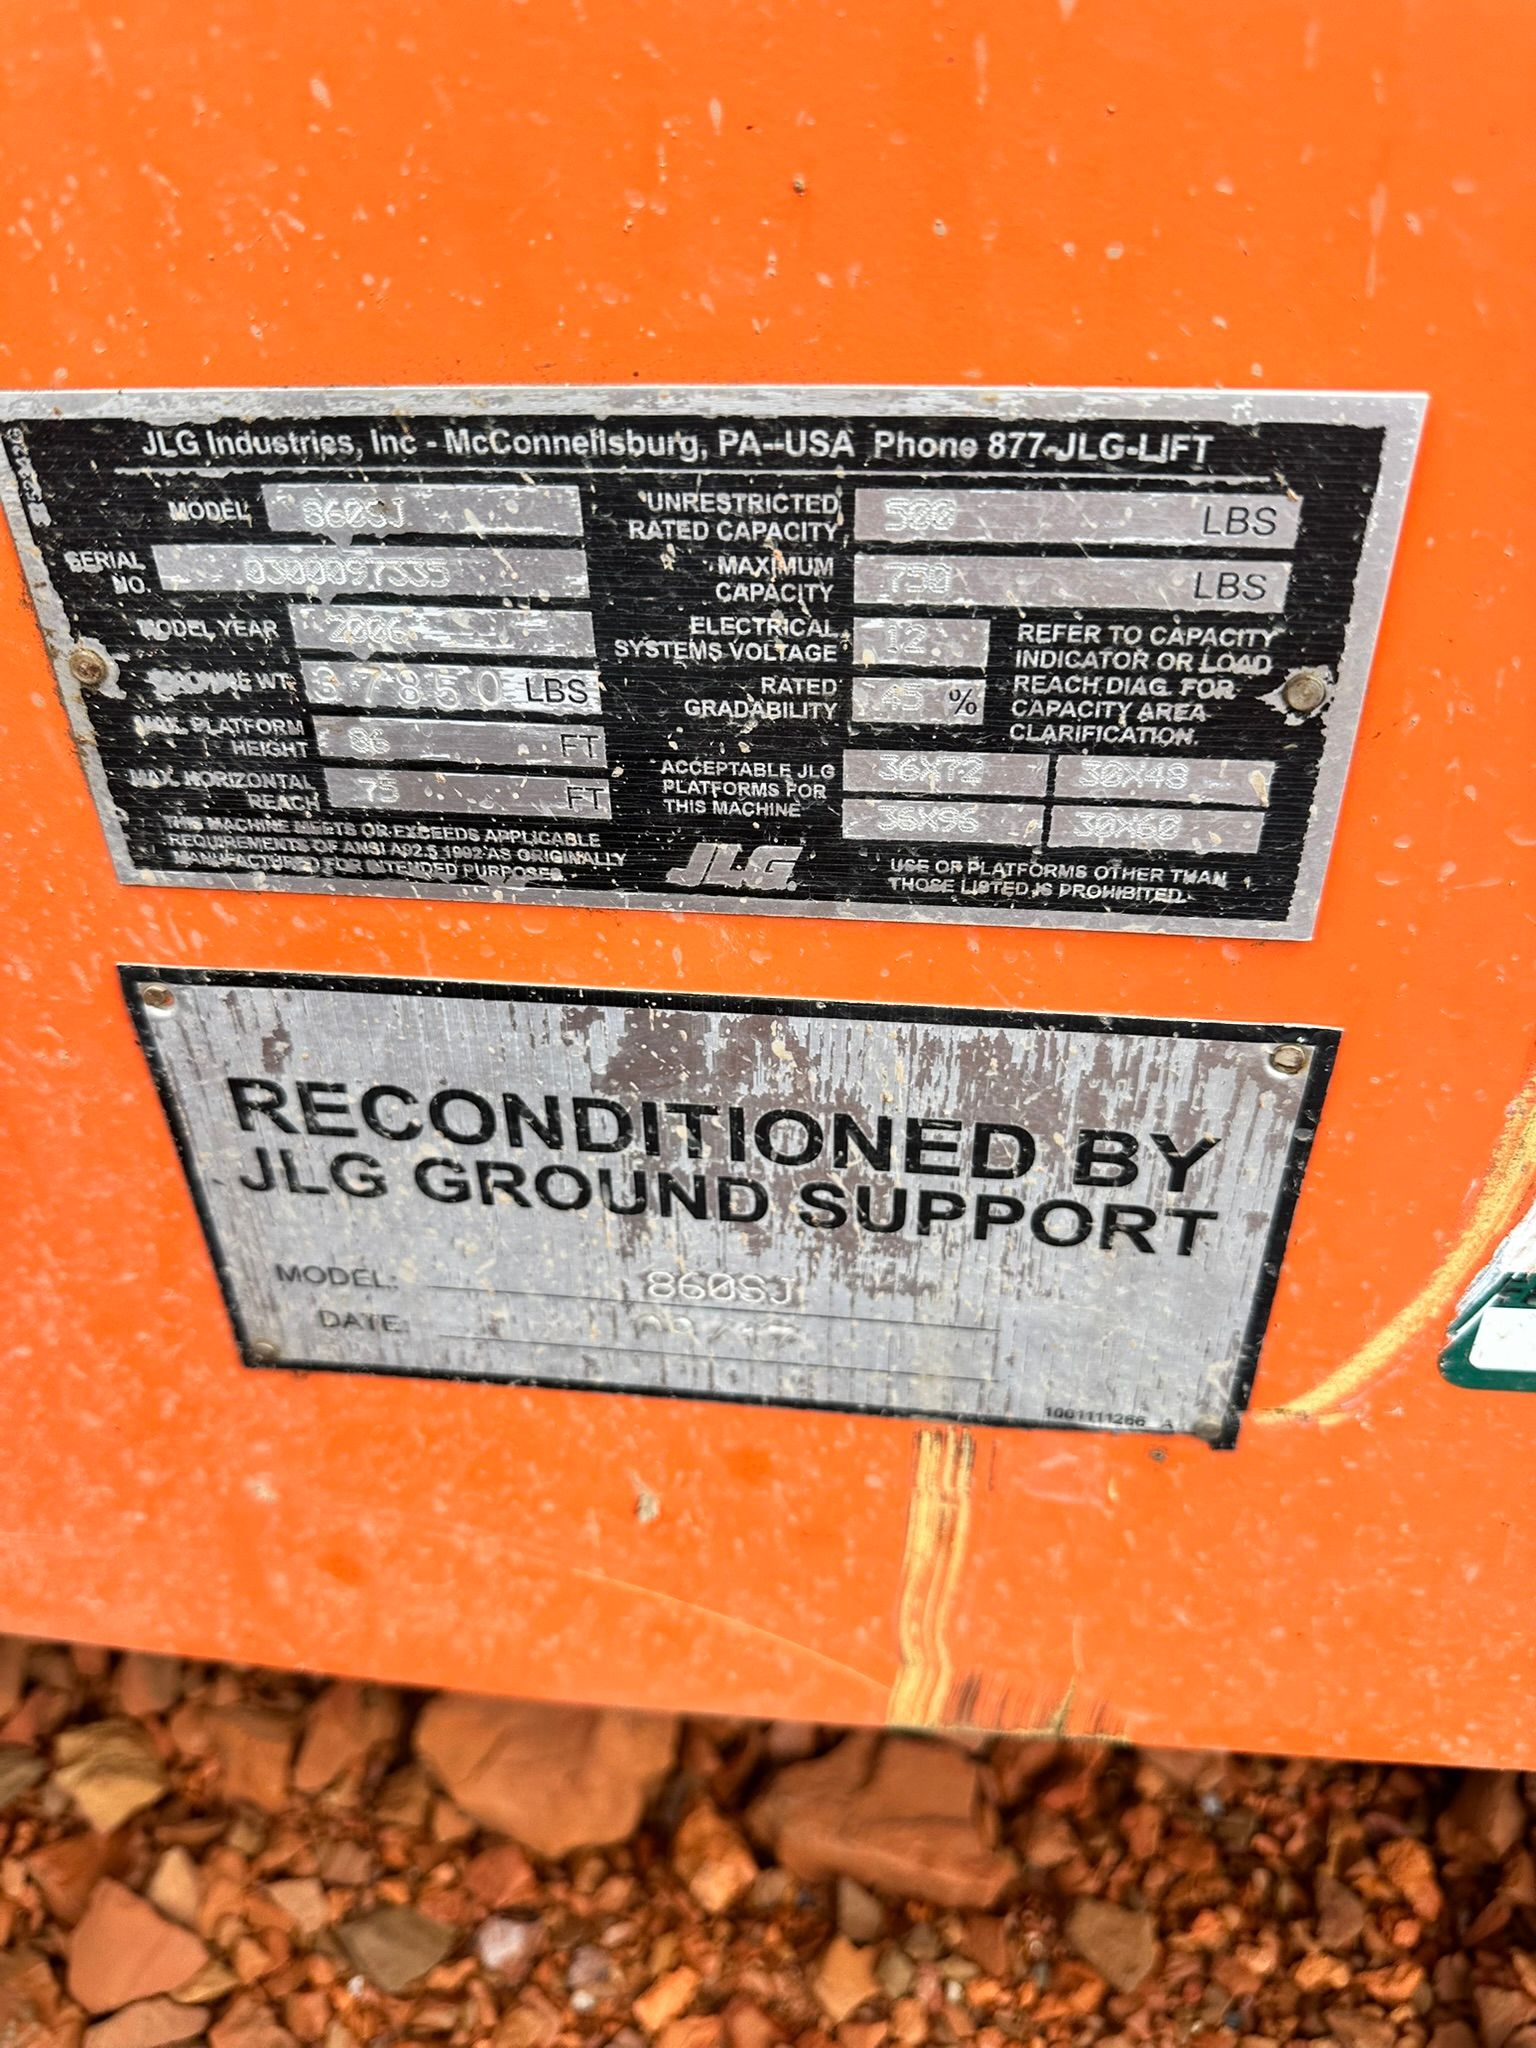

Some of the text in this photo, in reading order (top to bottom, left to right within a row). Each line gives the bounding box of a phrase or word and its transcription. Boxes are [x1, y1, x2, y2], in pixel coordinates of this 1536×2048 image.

[143, 431, 200, 458] JLG
[207, 431, 363, 462] Industries,
[370, 430, 417, 455] Inc
[873, 431, 978, 458] Phone
[167, 500, 251, 522] MODEL
[647, 492, 839, 515] UNRESTRICTED
[885, 498, 1277, 536] 500 LBS
[628, 520, 838, 543] RATED CAPACITY
[63, 550, 146, 573] SERIAL
[110, 575, 151, 595] NO.
[718, 556, 835, 577] MAXIMUM
[1194, 571, 1267, 601] LBS
[715, 583, 834, 603] CAPACITY
[217, 620, 279, 640] YEAR
[690, 616, 839, 638] ELECTRICAL
[1017, 623, 1278, 648] REFER TO CAPACITY
[614, 624, 927, 663] SYSTEMS VOLTAGE 12
[1015, 649, 1273, 675] INDICATOR OR LOAD
[525, 676, 589, 704] LBS
[761, 677, 838, 696] RATED
[949, 688, 978, 715] %
[1012, 674, 1101, 695] REACH
[1179, 678, 1238, 699] FOR
[684, 699, 838, 720] GRADABILITY
[1011, 700, 1133, 720] CAPACITY
[189, 716, 305, 736] PLATFORM
[1009, 723, 1199, 746] CLARIFICATION.
[230, 739, 309, 759] HEIGHT
[560, 733, 599, 759] FT
[182, 769, 317, 791] HORIZONTAL
[660, 759, 836, 780] ACCEPTABLE JLG
[248, 793, 321, 812] REACH
[565, 786, 605, 810] FT
[662, 780, 827, 800] PLATFORMS FOR
[664, 799, 802, 818] THIS MACHINE
[393, 825, 481, 842] EXCEEDS
[484, 829, 601, 848] APPLICABLE
[890, 858, 930, 874] USE
[967, 860, 1088, 878] PLATFORMS
[1094, 864, 1164, 882] OTHER
[888, 876, 955, 893] THOSE
[227, 1076, 1222, 1193] RECONDITIONED BY
[239, 1145, 1219, 1257] JLG GROUND SUPPORT
[275, 1263, 796, 1305] MODEL: 860SJ
